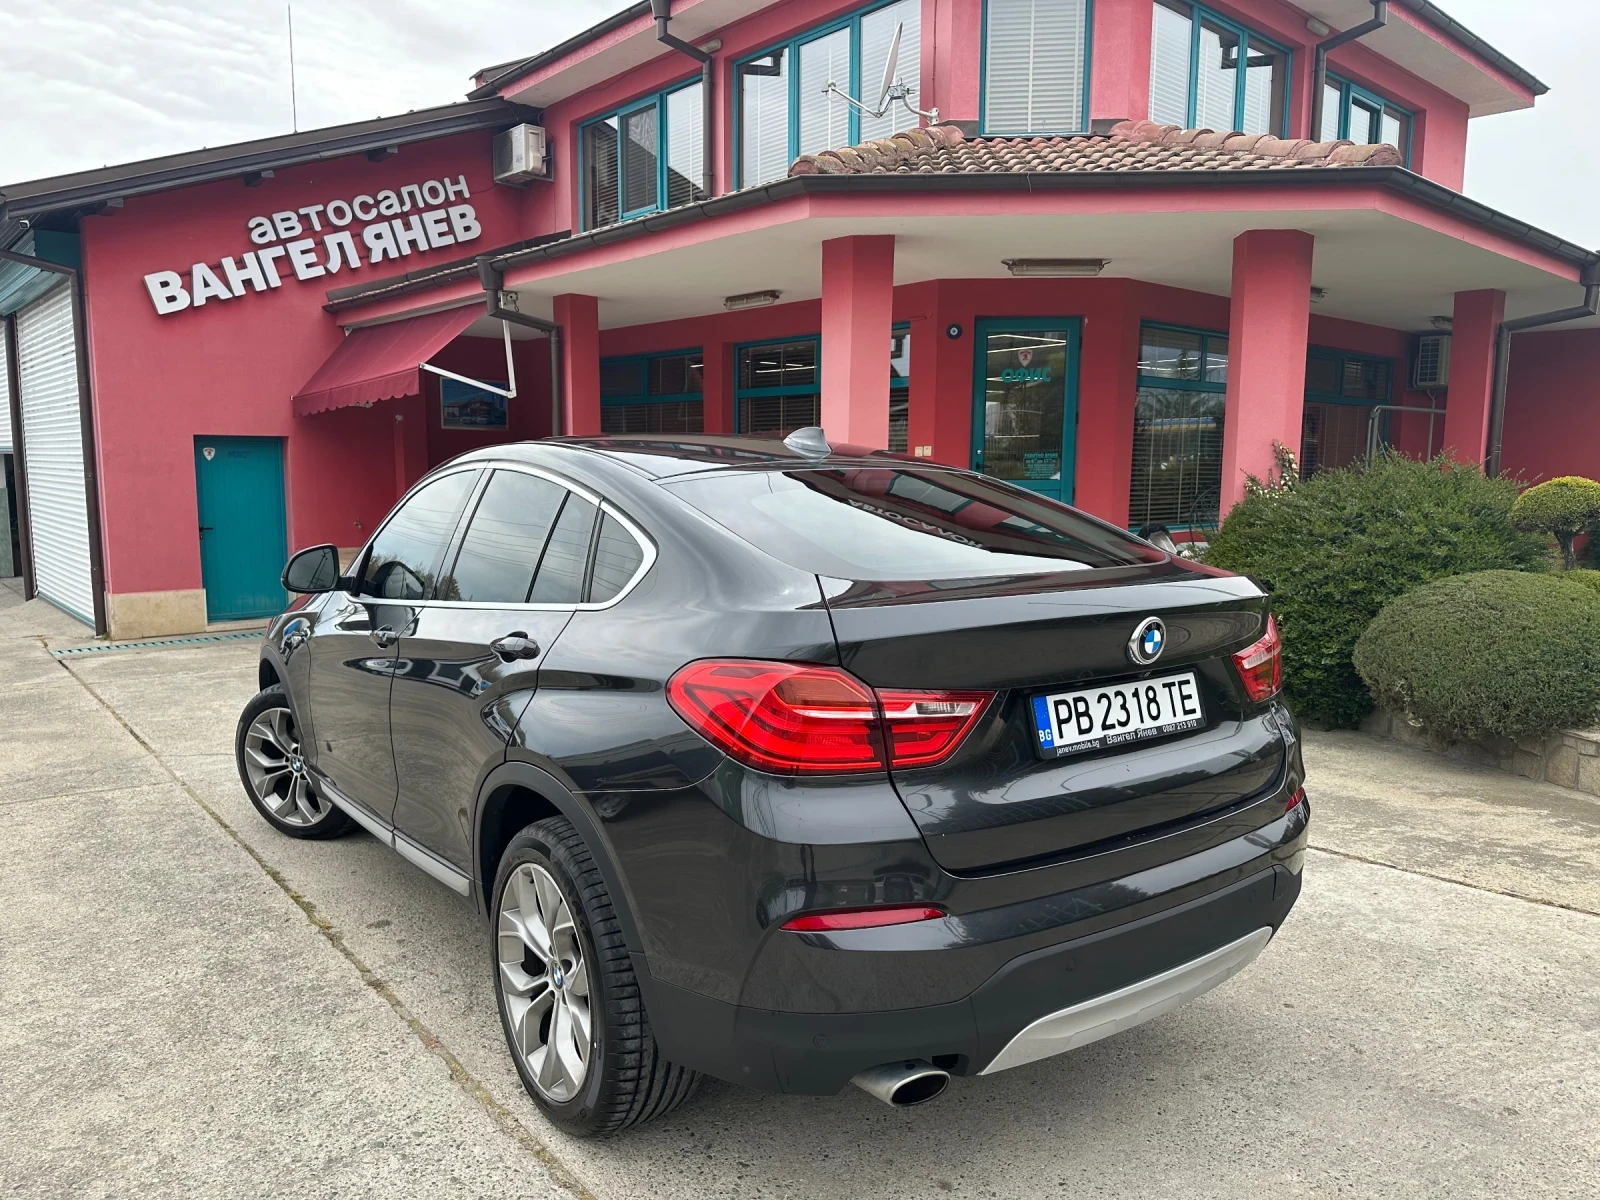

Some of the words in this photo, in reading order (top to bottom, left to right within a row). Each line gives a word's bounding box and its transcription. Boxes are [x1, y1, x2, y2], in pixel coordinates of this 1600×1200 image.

[143, 230, 362, 315] ВАНГЕЛ
[362, 204, 482, 264] ЯНЕВ
[1001, 367, 1052, 384] ОФИС
[1053, 696, 1094, 739] PB
[1097, 685, 1161, 731] 2318
[1162, 679, 1197, 718] TE
[1177, 721, 1187, 730] 213
[1187, 720, 1197, 728] 910
[1038, 729, 1052, 742] BG
[1106, 732, 1136, 744] Вангел
[1137, 728, 1158, 738] Янев
[1056, 740, 1100, 757] janev.mobile.bg
